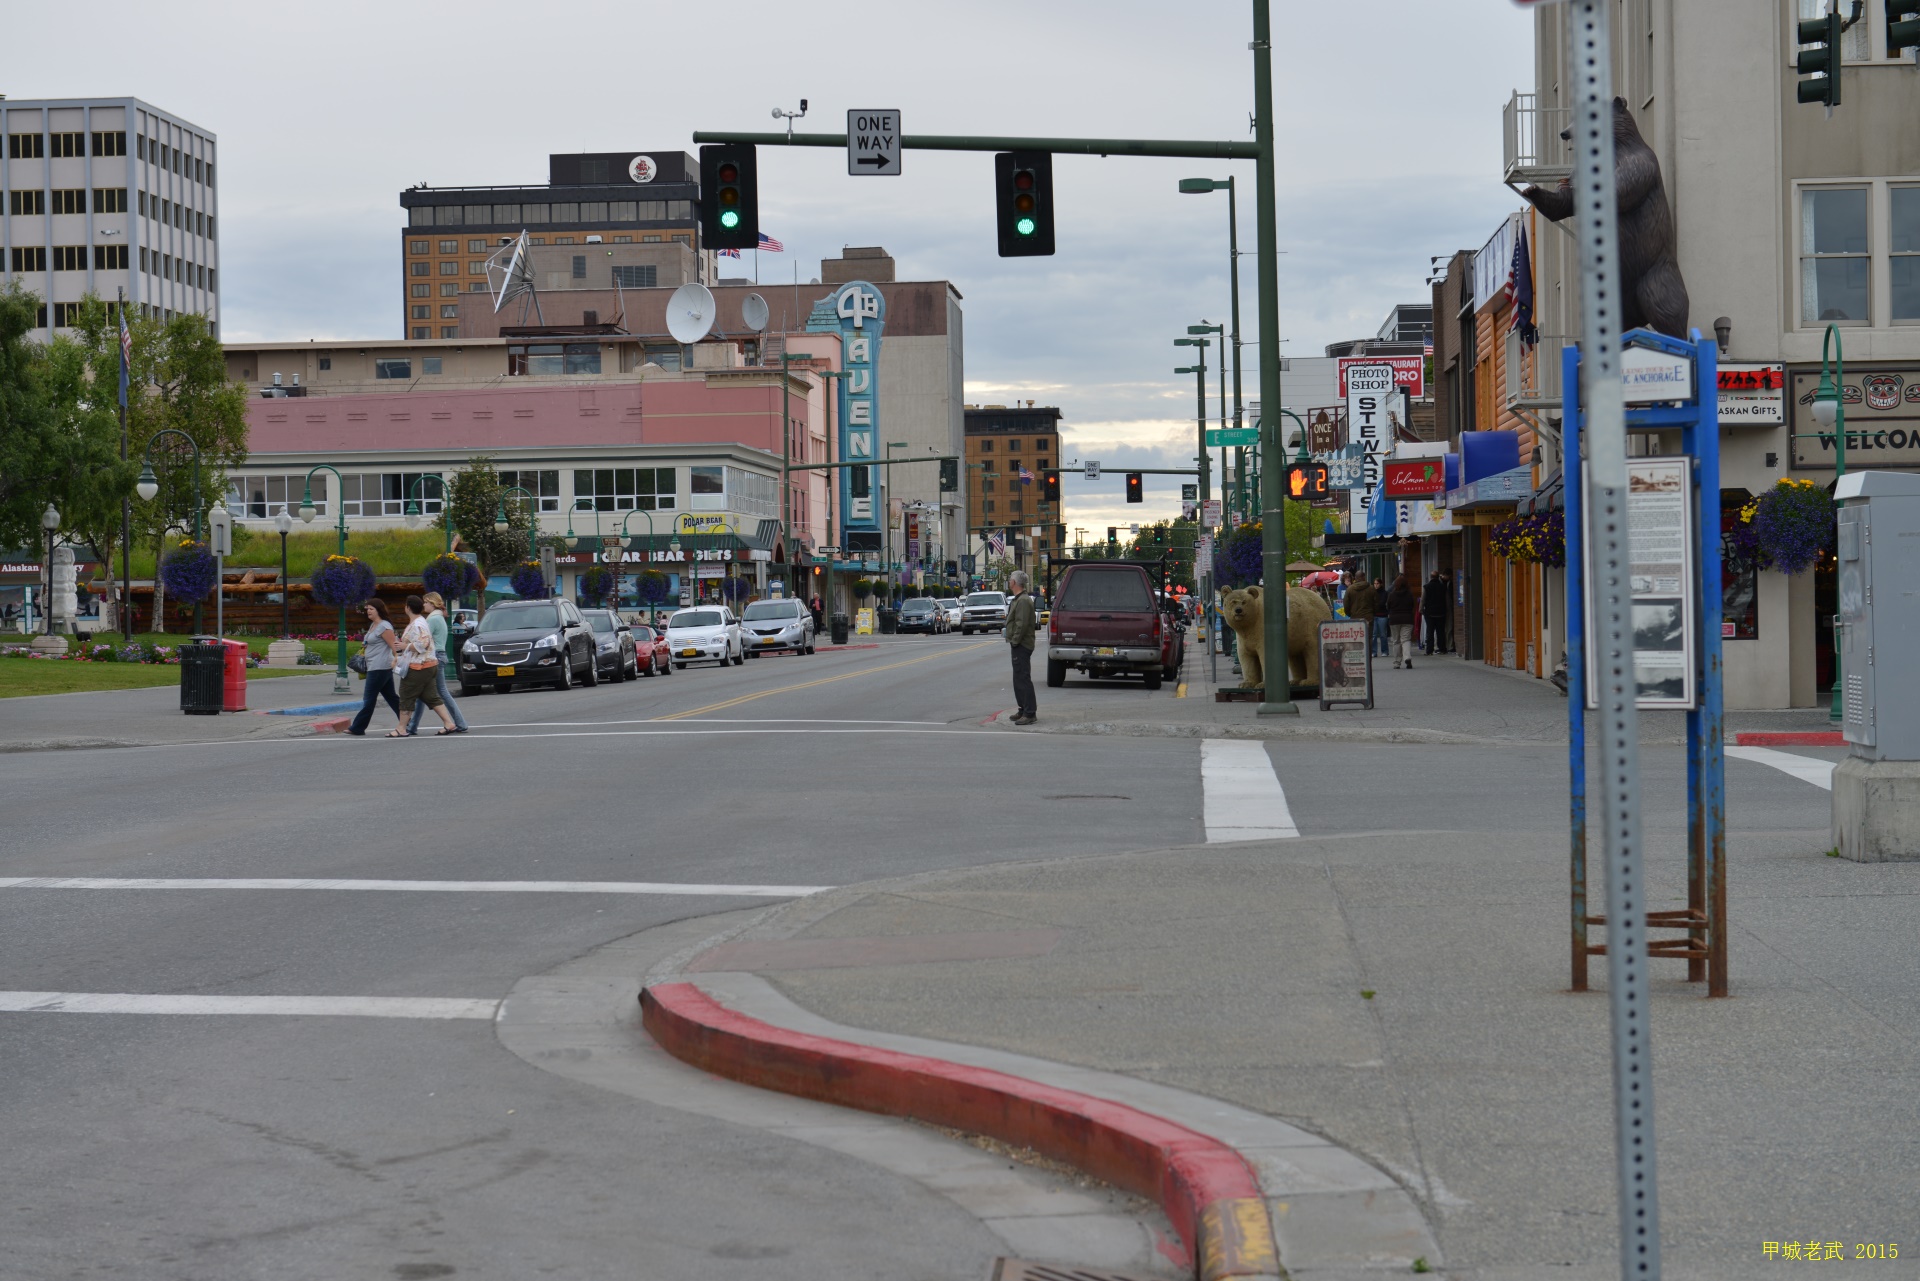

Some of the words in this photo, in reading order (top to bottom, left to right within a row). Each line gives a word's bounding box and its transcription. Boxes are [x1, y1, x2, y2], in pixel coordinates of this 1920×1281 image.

[857, 116, 892, 131] ONE
[857, 136, 893, 150] WAY
[1351, 369, 1389, 379] PHOTO
[1634, 365, 1684, 384] ANCHORAGE
[1351, 381, 1389, 390] SHOP
[848, 338, 873, 520] AVENE
[1314, 423, 1332, 433] ONCE
[1214, 432, 1220, 444] E
[1357, 397, 1380, 509] STEWARTS
[1316, 468, 1326, 492] 2
[1392, 471, 1424, 485] Salmon
[693, 549, 732, 561] GITS
[1, 563, 39, 572] Alaskan
[1322, 626, 1365, 641] Grizzly's
